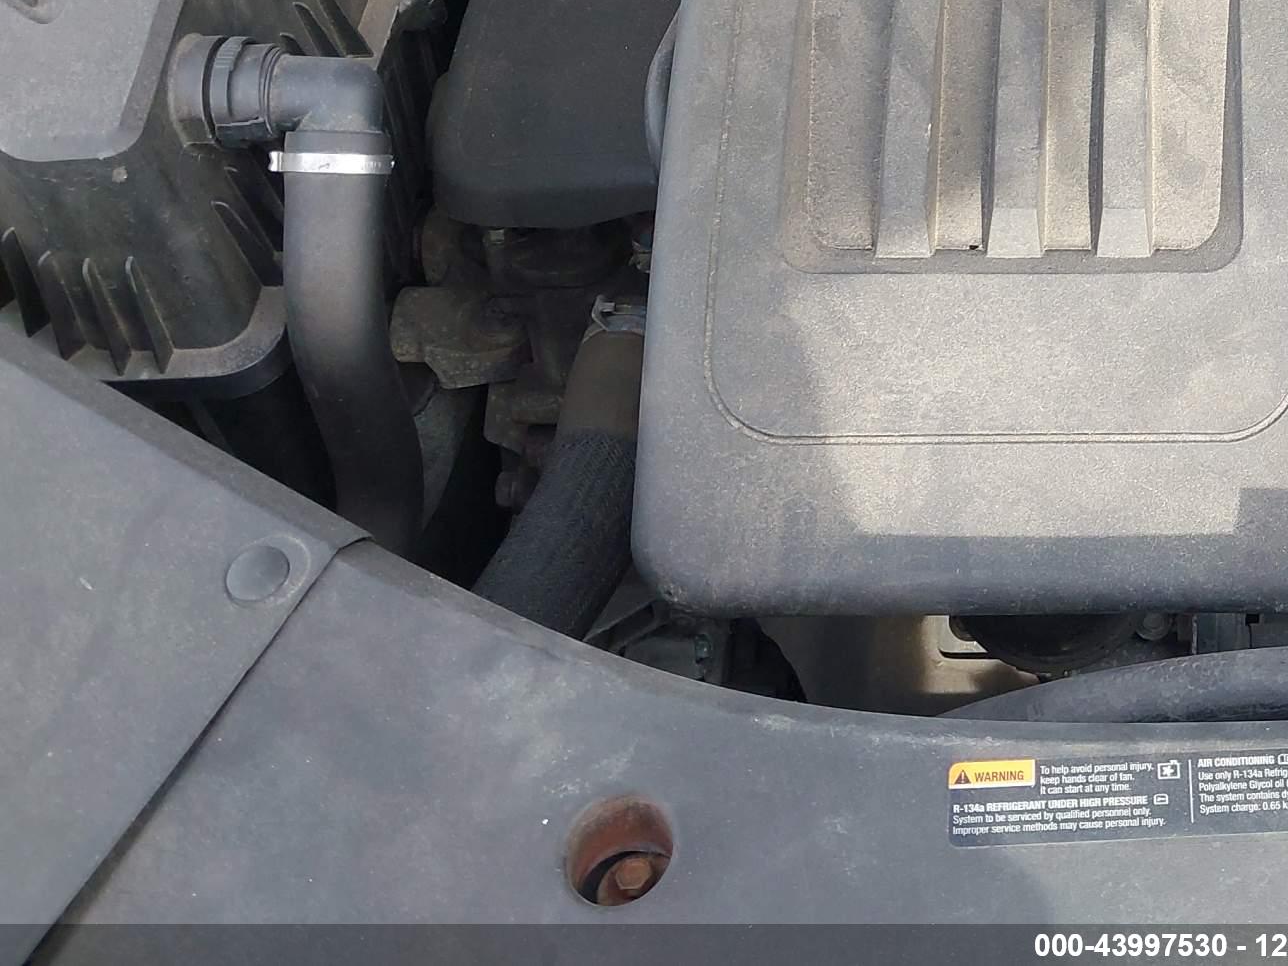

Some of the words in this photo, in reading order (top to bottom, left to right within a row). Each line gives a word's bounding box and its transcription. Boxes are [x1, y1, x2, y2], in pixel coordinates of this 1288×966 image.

[1198, 758, 1213, 768] AIR
[1215, 755, 1275, 767] CONDITIONING
[1040, 766, 1049, 774] To
[1051, 766, 1069, 776] help
[1071, 764, 1092, 773] avoid
[1094, 763, 1128, 774] personal
[1198, 771, 1213, 780] Use
[1215, 770, 1231, 781] only
[1233, 769, 1263, 779] R-134a
[975, 771, 1024, 782] WARNING
[1041, 776, 1059, 785] keep
[1062, 775, 1086, 783] hands
[1088, 774, 1106, 782] clear
[1109, 773, 1117, 781] of
[1119, 772, 1134, 781] fan.
[1049, 786, 1063, 794] can
[1065, 784, 1083, 793] start
[1085, 784, 1093, 792] at
[1095, 784, 1110, 794] any
[1112, 783, 1131, 791] time.
[1199, 781, 1247, 792] Polyalkylene
[1249, 780, 1272, 790] Glycol
[1275, 779, 1284, 788] oil
[1200, 794, 1214, 802] The
[1216, 793, 1244, 803] system
[1246, 791, 1279, 800] contains
[953, 803, 984, 812] R-134a
[987, 801, 1046, 811] REFRIGERANT
[1048, 799, 1077, 809] UNDER
[1080, 798, 1101, 807] HIGH
[1103, 796, 1148, 806] PRESSURE
[1200, 805, 1229, 815] System
[1231, 803, 1261, 814] charge:
[1263, 801, 1281, 811] 0.65
[953, 813, 983, 824] System
[986, 814, 993, 822] to
[995, 813, 1006, 821] be
[1008, 812, 1041, 821] serviced
[1044, 811, 1053, 821] by
[1056, 809, 1089, 821] qualified
[1092, 808, 1131, 818] personnel
[1133, 807, 1151, 817] only.
[953, 825, 989, 836] Improper
[991, 824, 1020, 833] service
[1023, 823, 1058, 832] methods
[1060, 821, 1077, 831] may
[1079, 821, 1103, 829] cause
[1105, 818, 1139, 829] personal
[1141, 817, 1165, 827] injury.
